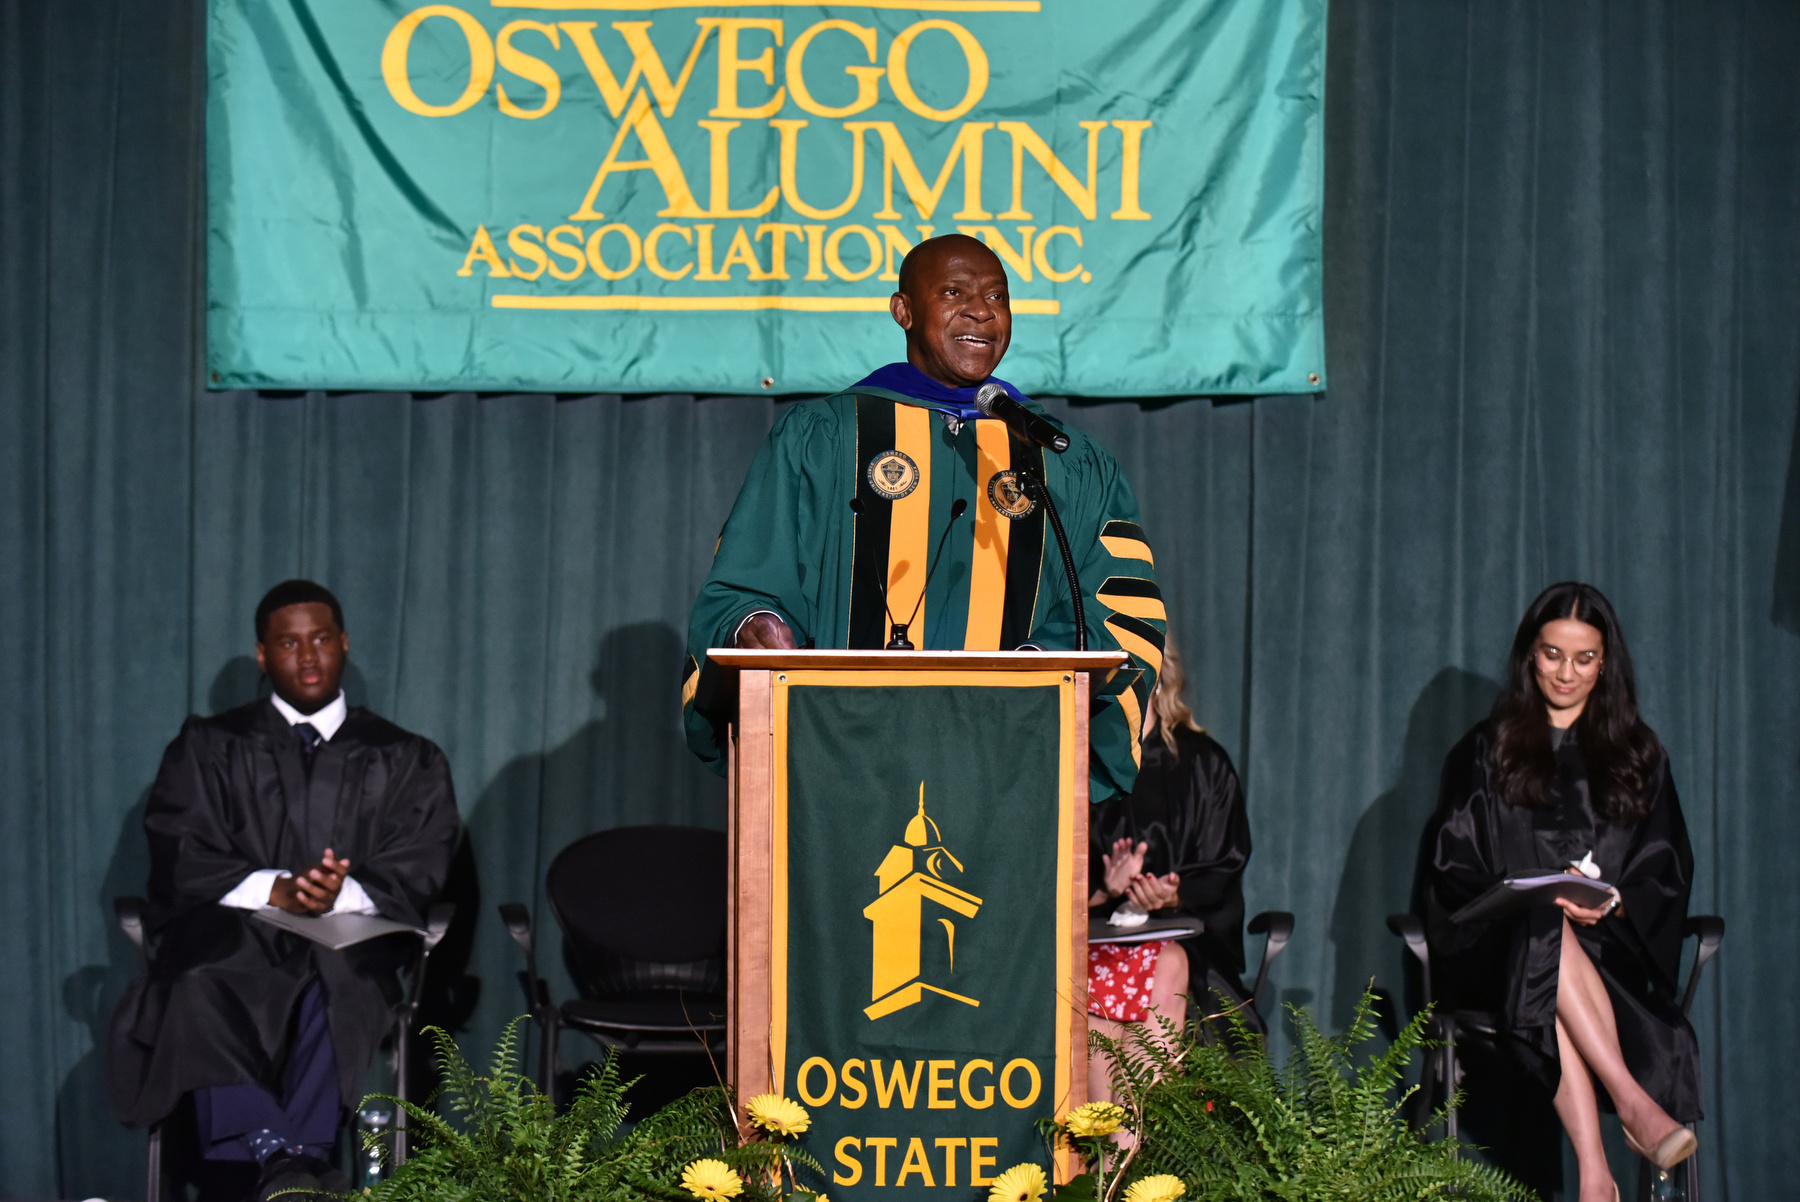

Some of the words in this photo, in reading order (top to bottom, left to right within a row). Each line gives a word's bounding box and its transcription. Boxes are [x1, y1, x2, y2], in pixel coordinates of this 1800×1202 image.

[381, 5, 989, 121] OSWEGO
[569, 87, 1153, 221] ALUMNI
[796, 1056, 1042, 1110] OSWEGO
[833, 1136, 999, 1187] STATE
